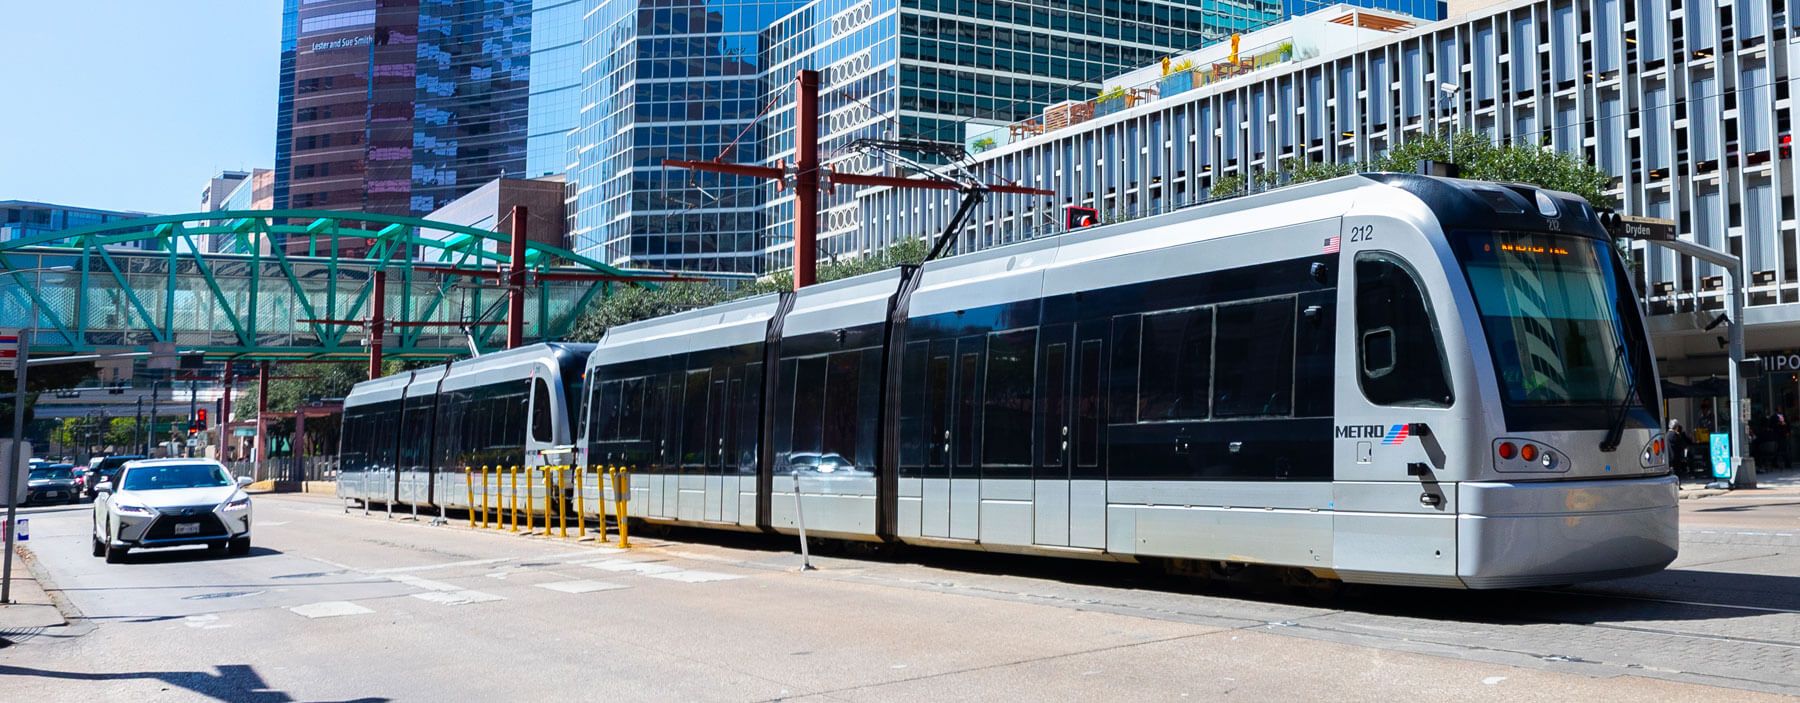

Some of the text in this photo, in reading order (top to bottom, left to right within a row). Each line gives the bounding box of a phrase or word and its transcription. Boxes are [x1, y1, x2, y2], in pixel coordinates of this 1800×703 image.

[312, 35, 373, 50] Lester and Sue Smith
[1351, 224, 1373, 242] 212
[1625, 223, 1650, 237] Dryden
[1335, 424, 1384, 439] METRO
